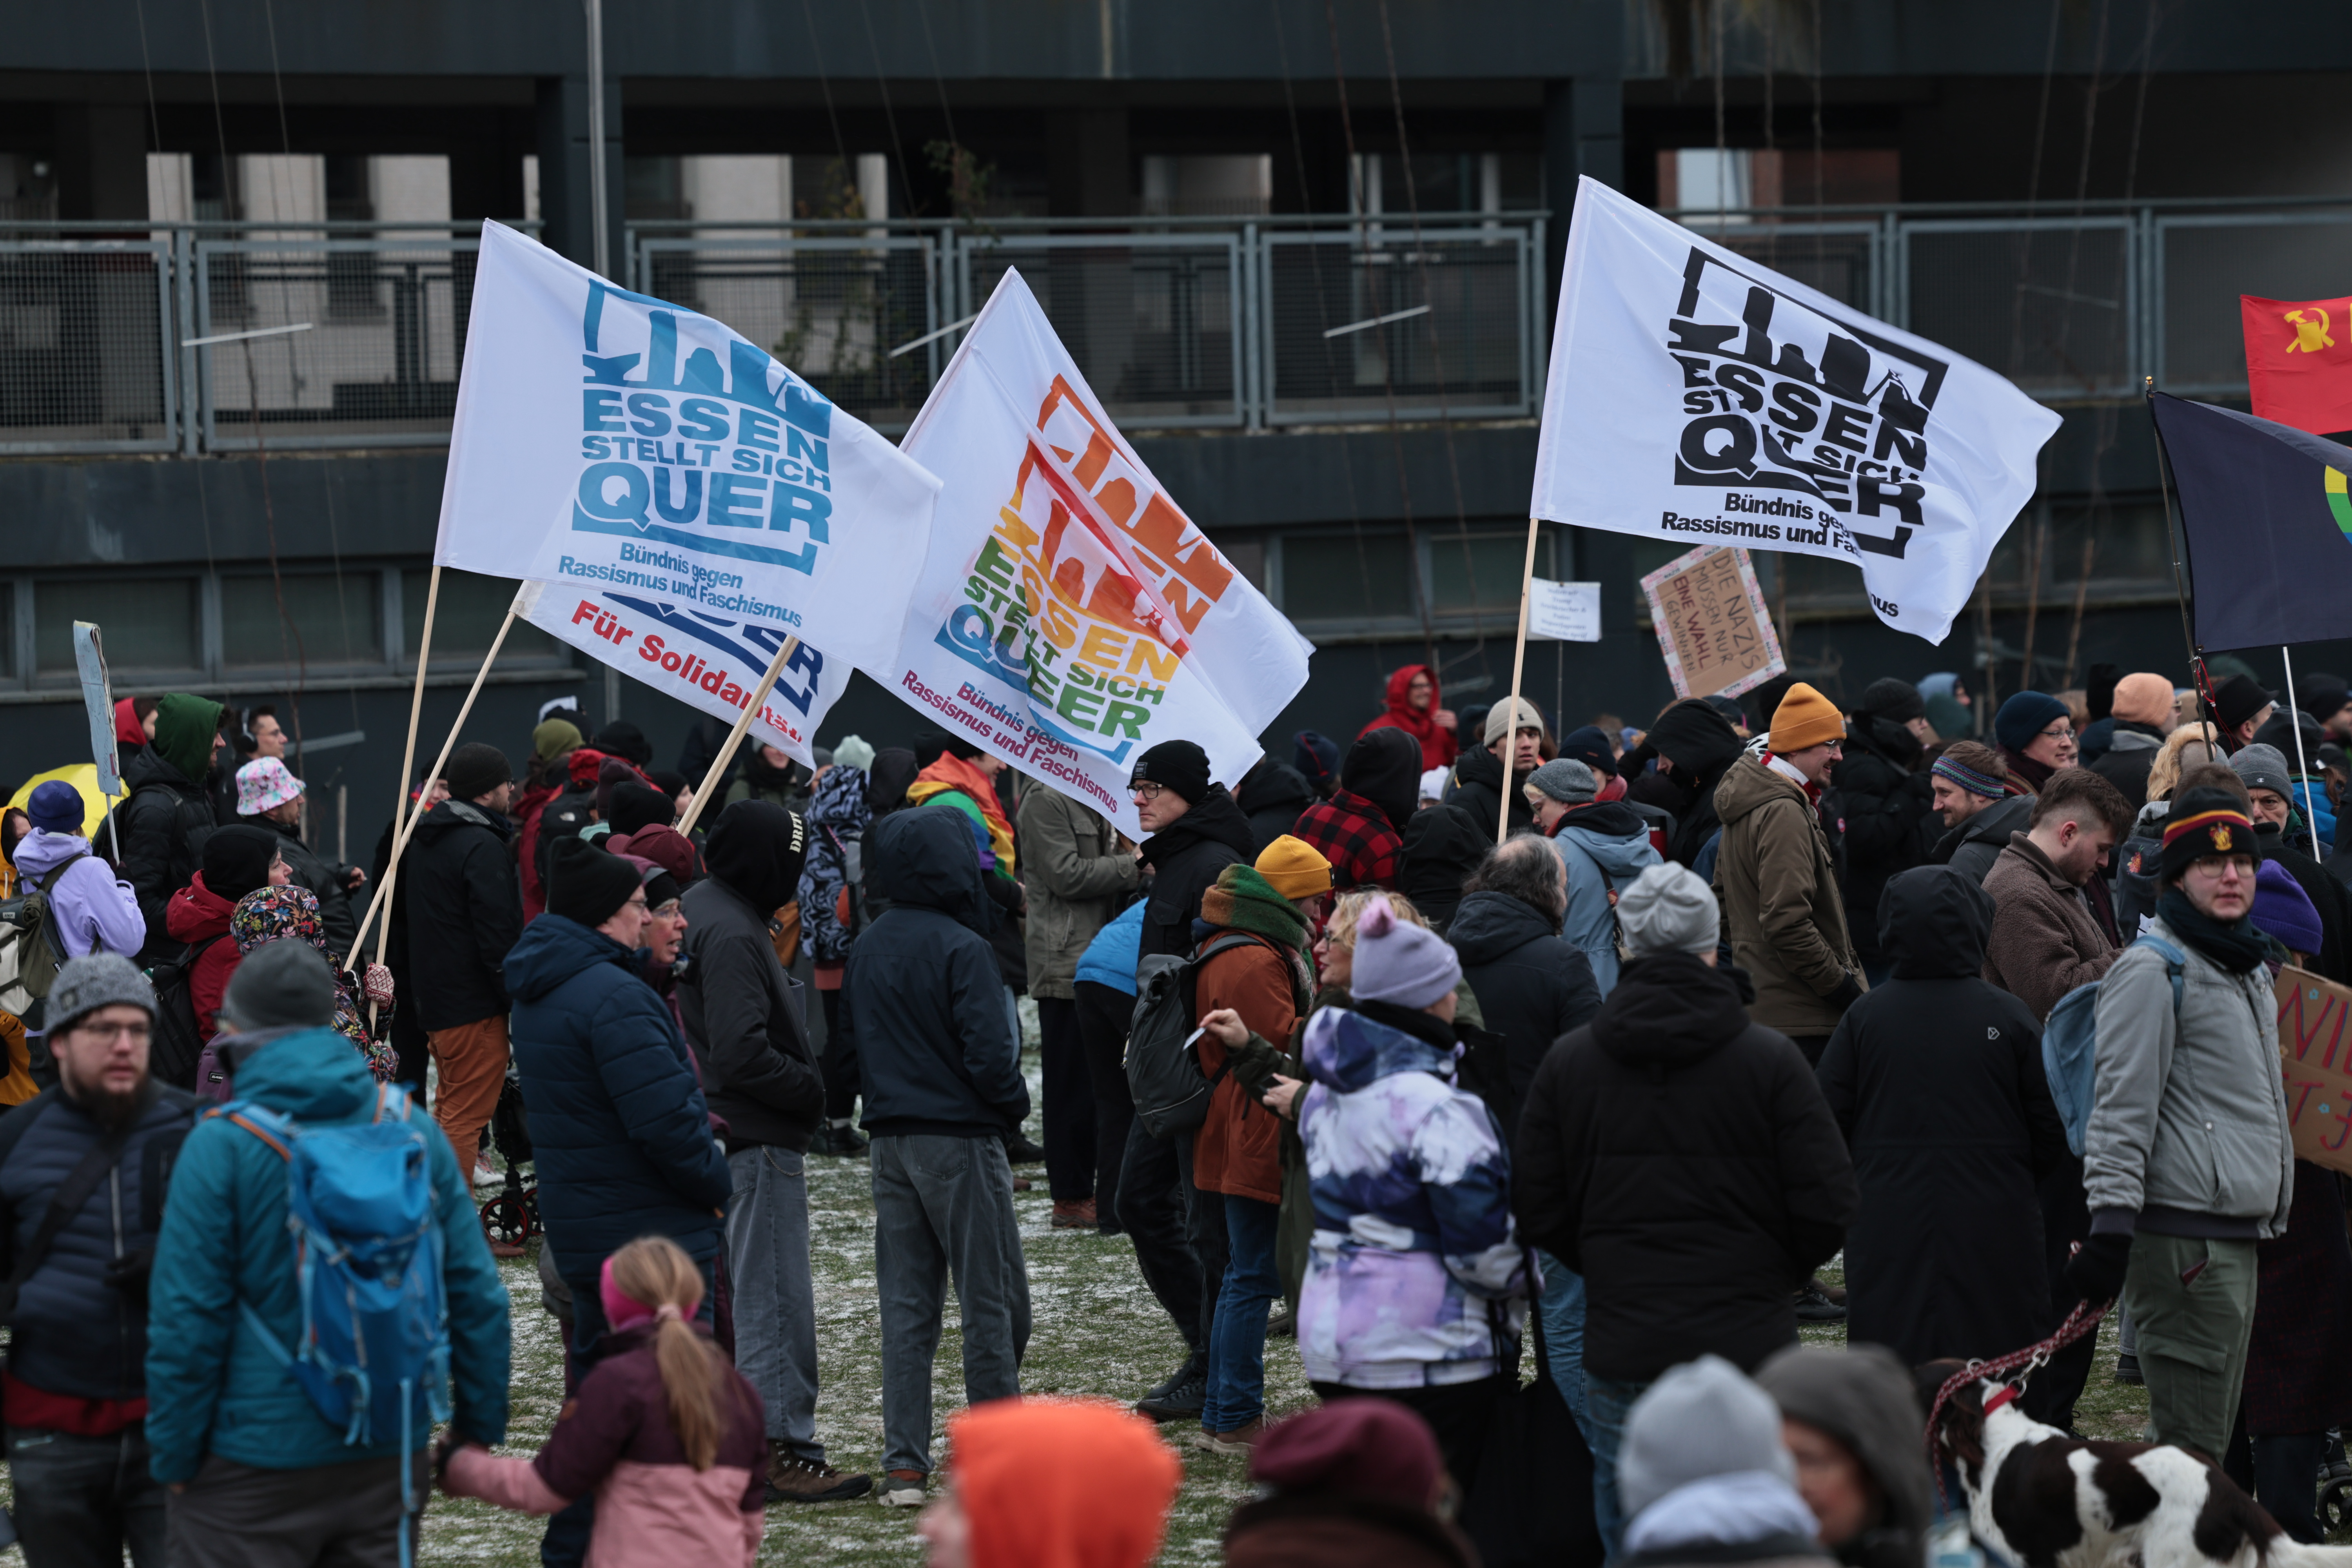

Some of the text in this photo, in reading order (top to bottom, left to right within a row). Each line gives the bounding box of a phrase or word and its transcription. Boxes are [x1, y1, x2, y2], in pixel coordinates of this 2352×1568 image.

[583, 389, 829, 474] ESSEN
[1669, 352, 1927, 472] ESSEN
[582, 435, 831, 492] STELLT SICH
[579, 462, 832, 544] QUER
[1661, 512, 1780, 539] Rassismus
[1786, 526, 1828, 546] und
[1725, 493, 1813, 520] Bündnis
[559, 555, 802, 627] Rassismus und Faschismus
[619, 542, 743, 588] Bündnis gegen
[1712, 552, 1737, 591] DIE
[571, 600, 633, 645] Für
[1667, 600, 1696, 671] GEWINNEN
[1673, 575, 1711, 669] EINE WAHL
[1692, 566, 1722, 625] MÜSSEN
[1713, 630, 1734, 665] NUR
[1724, 594, 1761, 670] NAZIS
[1066, 661, 1166, 705] SICH
[902, 669, 1118, 813] Rassismus und Faschismus
[957, 681, 1078, 762] Bündnis gegen
